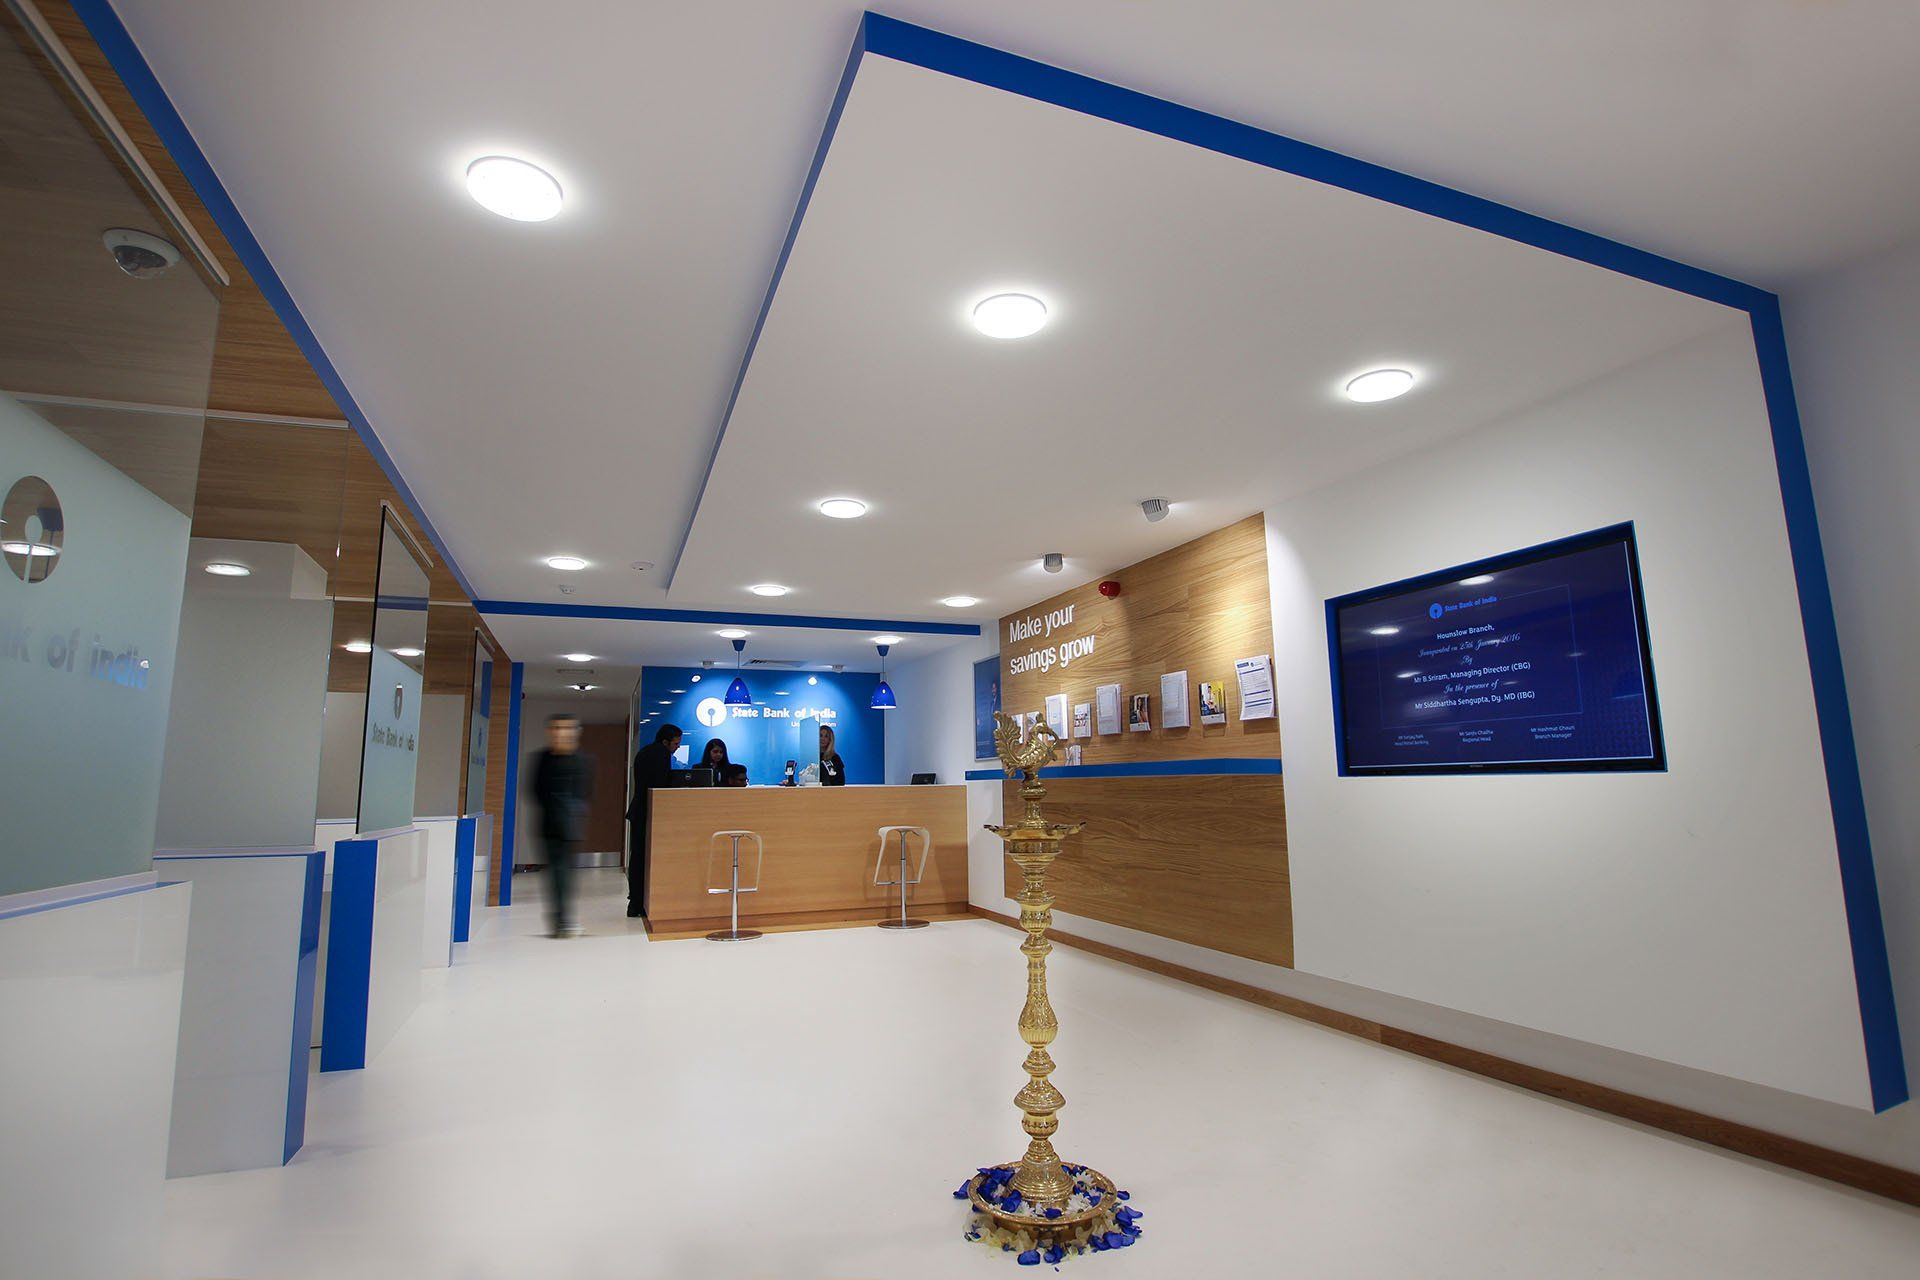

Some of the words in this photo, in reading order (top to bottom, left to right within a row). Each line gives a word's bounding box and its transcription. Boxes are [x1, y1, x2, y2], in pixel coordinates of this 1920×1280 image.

[1459, 601, 1474, 609] Bank
[1474, 598, 1481, 606] of
[1482, 596, 1498, 604] India
[1009, 615, 1042, 643] Make
[1044, 604, 1075, 638] your
[1436, 629, 1468, 640] Hounslow
[1500, 632, 1521, 643] 2016
[47, 628, 81, 673] of
[1010, 647, 1057, 675] savings
[1059, 634, 1095, 668] grow
[1461, 655, 1473, 665] By
[1450, 669, 1482, 679] Managing
[1483, 665, 1510, 674] Director
[1511, 662, 1531, 672] (CBG)
[1454, 683, 1463, 692] the
[1424, 700, 1457, 708] Siddhartha
[1517, 691, 1535, 701] (IBG)
[732, 706, 759, 718] State
[763, 707, 790, 718] Bank
[794, 707, 807, 719] of
